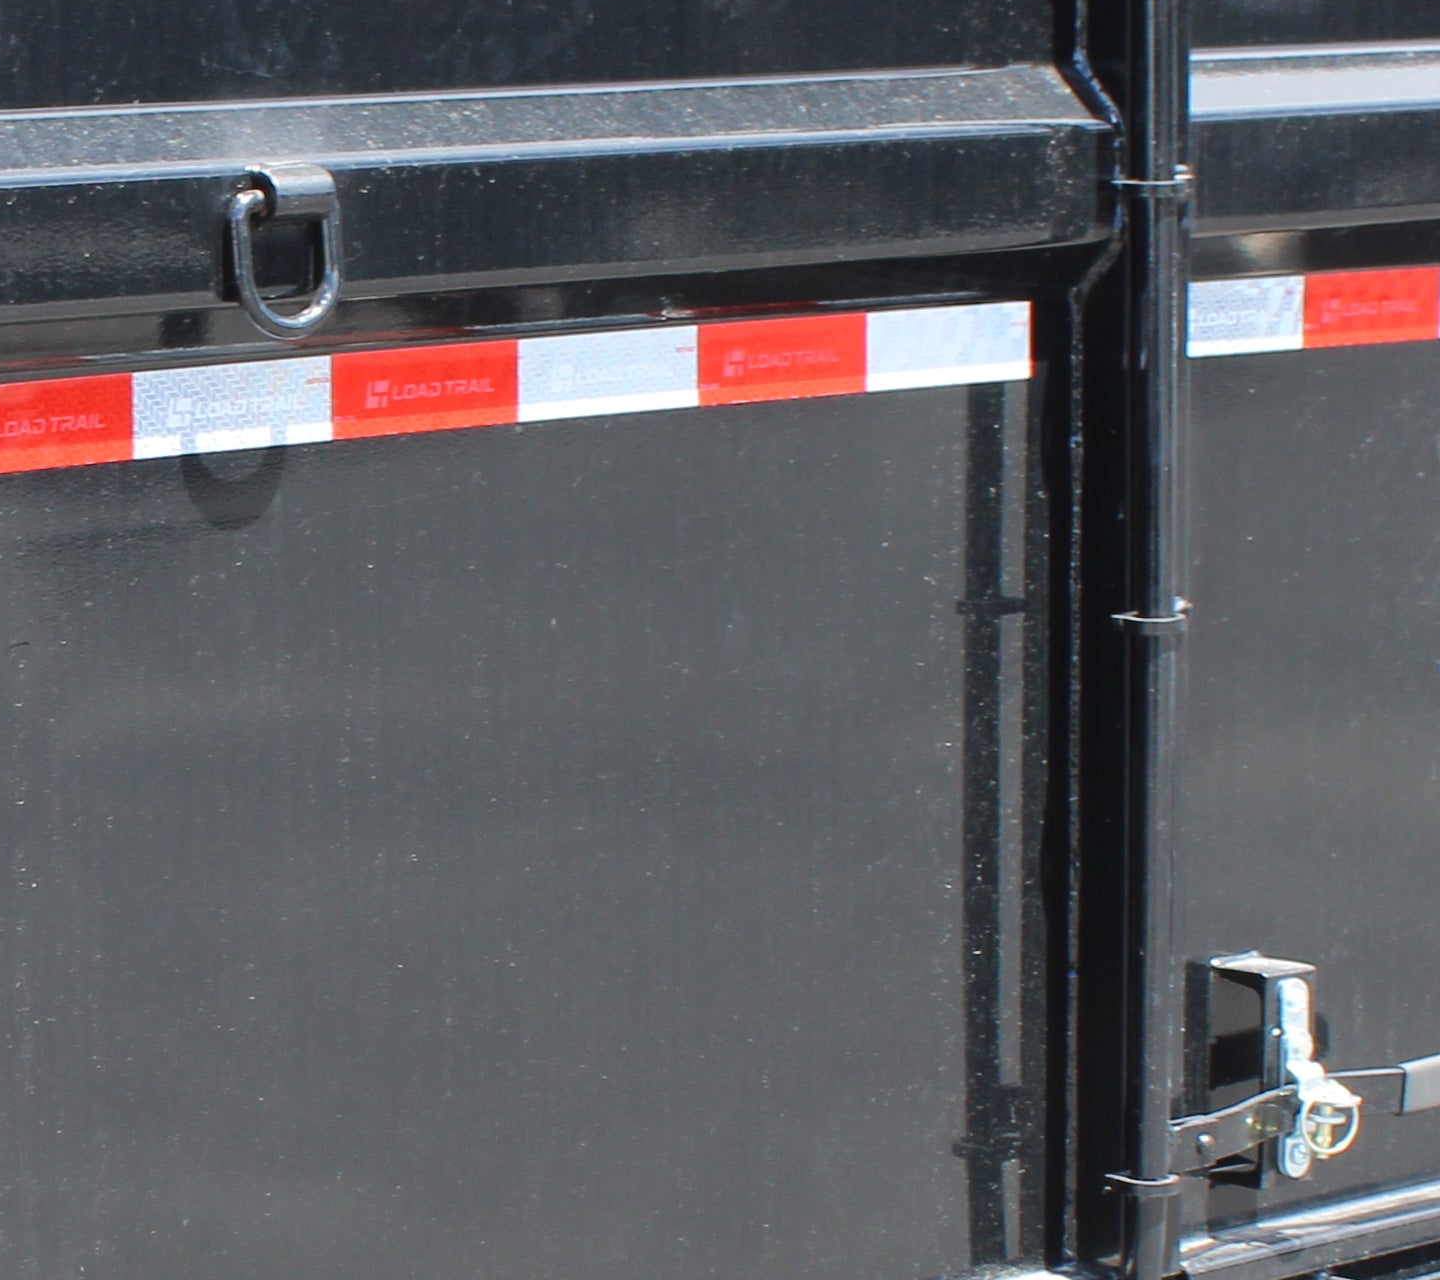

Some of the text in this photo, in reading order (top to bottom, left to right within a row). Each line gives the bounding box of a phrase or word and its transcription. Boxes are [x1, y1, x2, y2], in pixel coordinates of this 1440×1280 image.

[748, 347, 840, 370] LOAD TRAIL
[391, 377, 495, 401] LOAD TRAIL
[195, 398, 247, 419] LOAD
[49, 412, 106, 433] TRAIL
